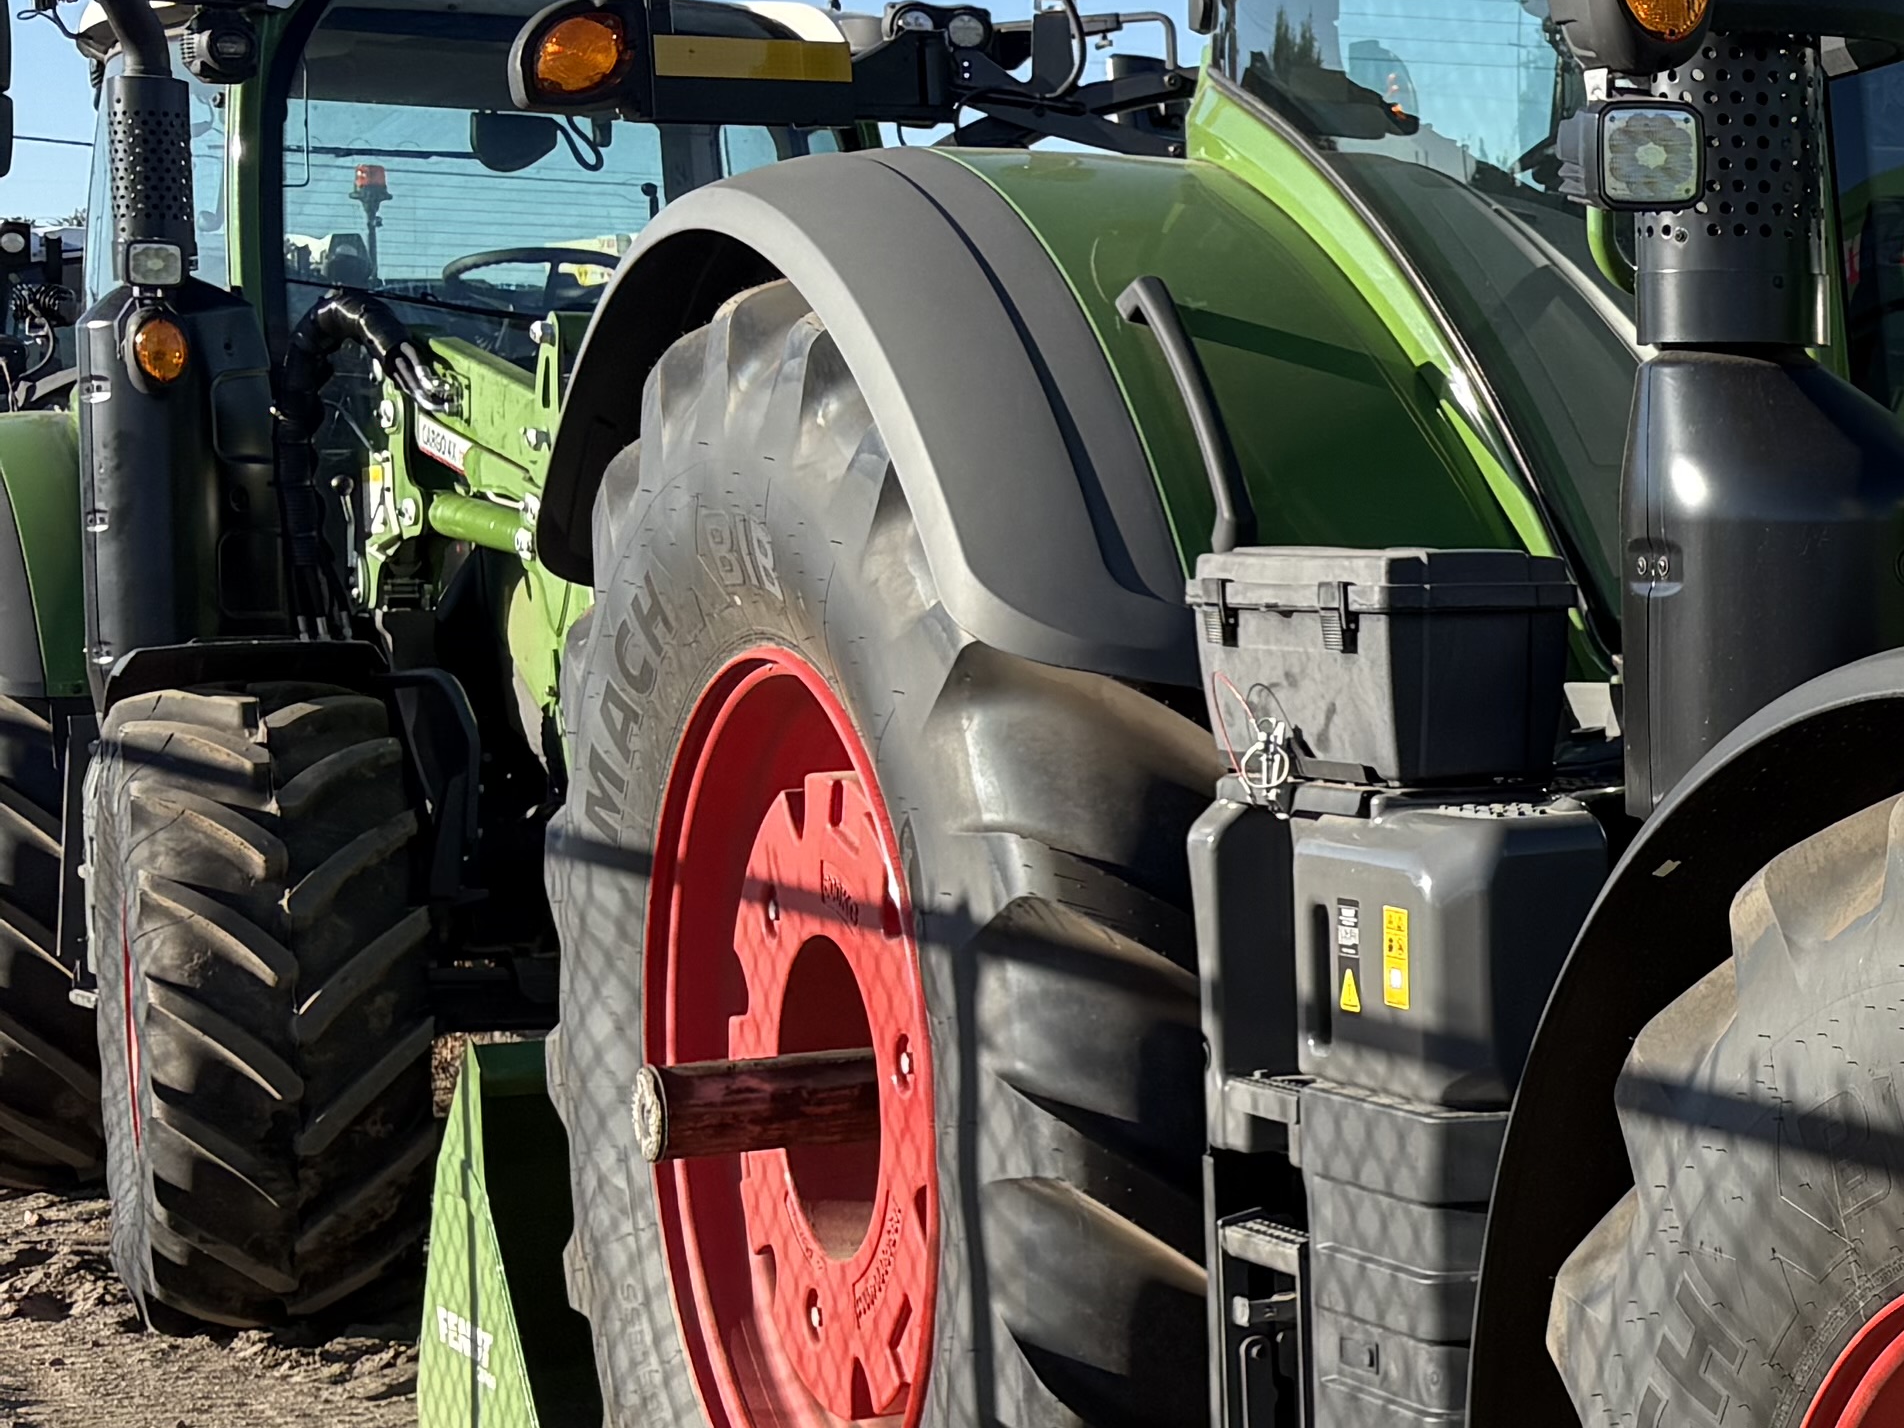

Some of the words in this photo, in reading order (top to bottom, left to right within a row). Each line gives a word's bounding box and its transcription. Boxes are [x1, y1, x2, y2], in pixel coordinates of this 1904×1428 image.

[584, 571, 676, 847] MACH
[698, 509, 785, 601] BIB
[436, 1305, 494, 1370] FENDT
